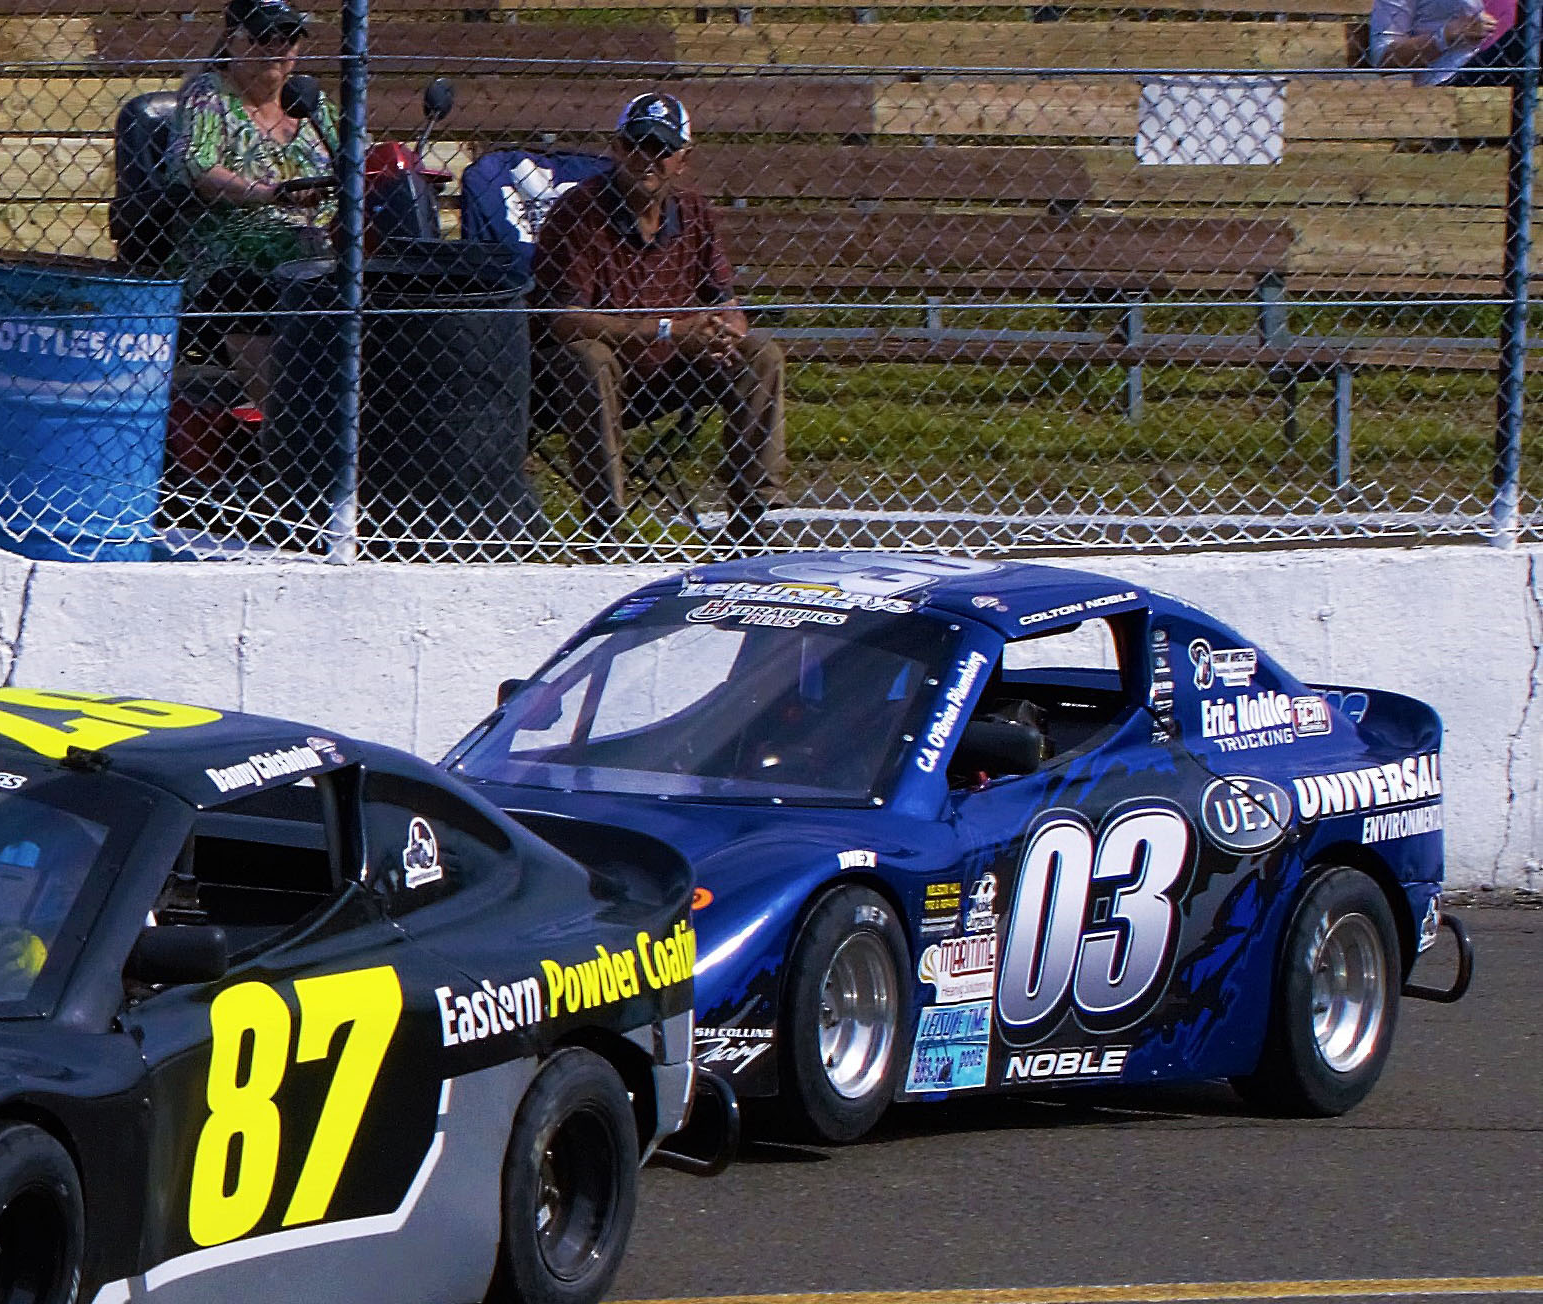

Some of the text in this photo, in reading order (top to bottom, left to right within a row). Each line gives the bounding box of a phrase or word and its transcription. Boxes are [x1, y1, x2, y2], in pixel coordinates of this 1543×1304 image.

[1019, 604, 1084, 626] COLTON
[1085, 591, 1138, 610] NOBLE
[946, 651, 988, 707] Plumbing
[1201, 698, 1236, 738] Eric
[1236, 690, 1293, 733] Noble
[1214, 727, 1294, 753] TRUCKING
[205, 762, 262, 793] Danny
[1293, 753, 1441, 819] UNIVERSAL
[998, 807, 1190, 1026] 03
[435, 976, 542, 1046] Eastern
[540, 944, 640, 1018] Powder
[718, 1028, 774, 1038] COLLINS
[1006, 1050, 1128, 1079] NOBLE
[189, 964, 403, 1247] 87
